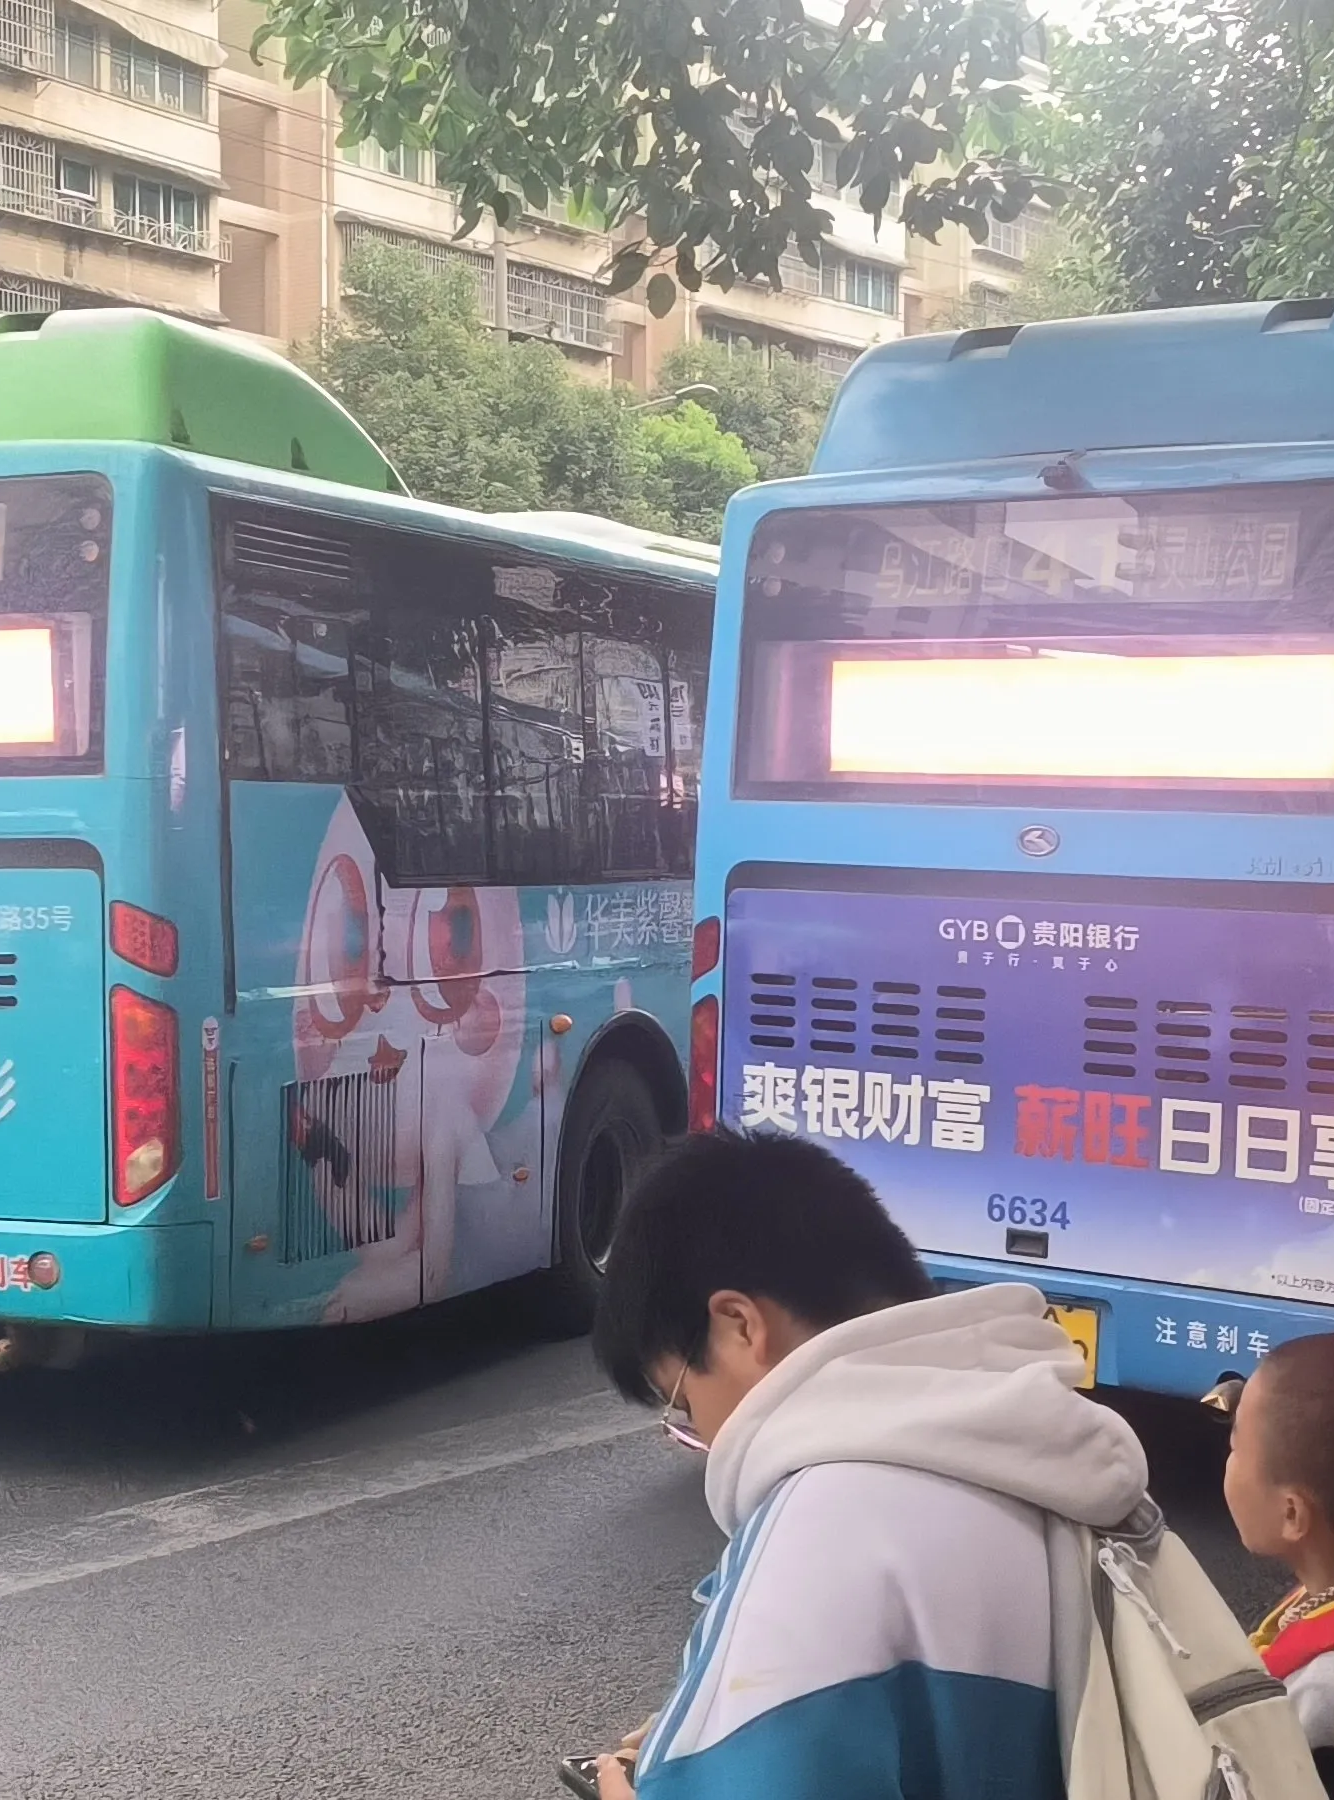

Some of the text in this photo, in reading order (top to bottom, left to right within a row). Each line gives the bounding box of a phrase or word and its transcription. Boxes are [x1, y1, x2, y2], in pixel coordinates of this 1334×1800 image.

[938, 918, 990, 942] GYB
[1031, 919, 1141, 951] 贵阳银行
[741, 1061, 992, 1153] 爽银财富
[986, 1192, 1072, 1230] 6634
[1154, 1315, 1270, 1360] 注意刹车
